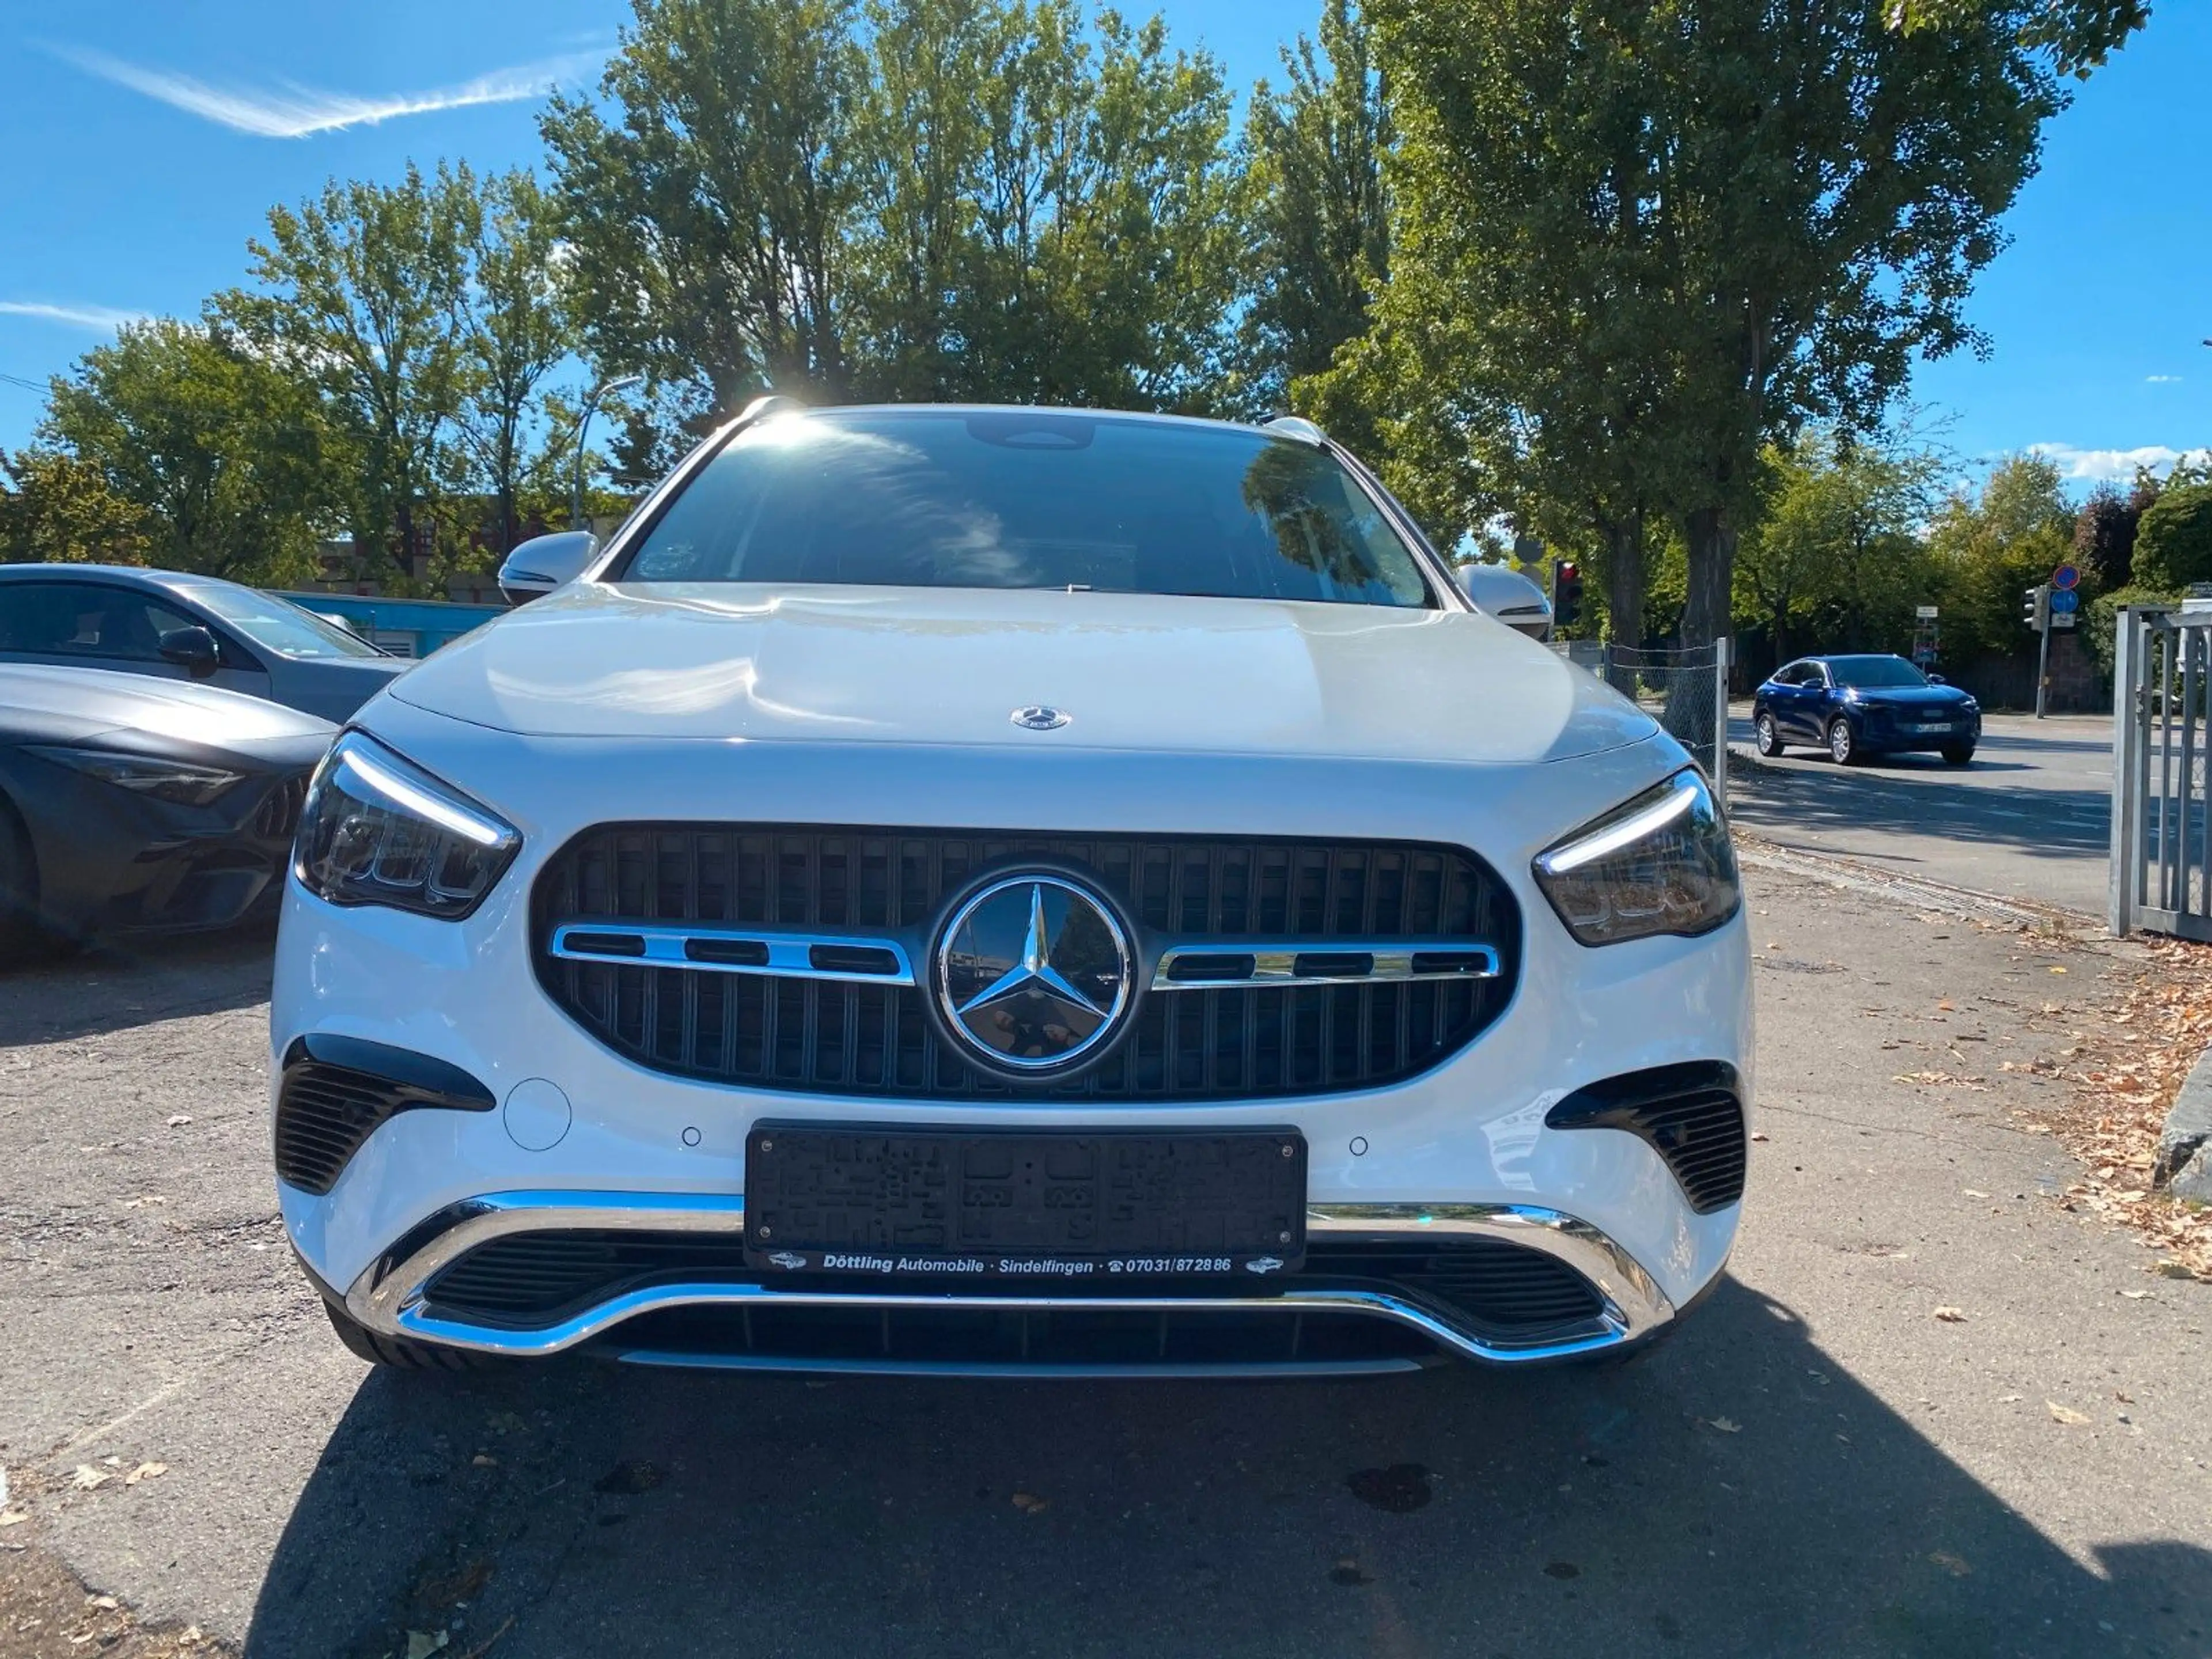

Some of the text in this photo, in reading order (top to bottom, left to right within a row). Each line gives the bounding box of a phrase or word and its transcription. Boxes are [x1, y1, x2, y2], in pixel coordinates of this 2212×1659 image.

[824, 1255, 893, 1272] Döttling
[896, 1257, 984, 1272] Automobile
[999, 1259, 1094, 1275] Sindelfingen
